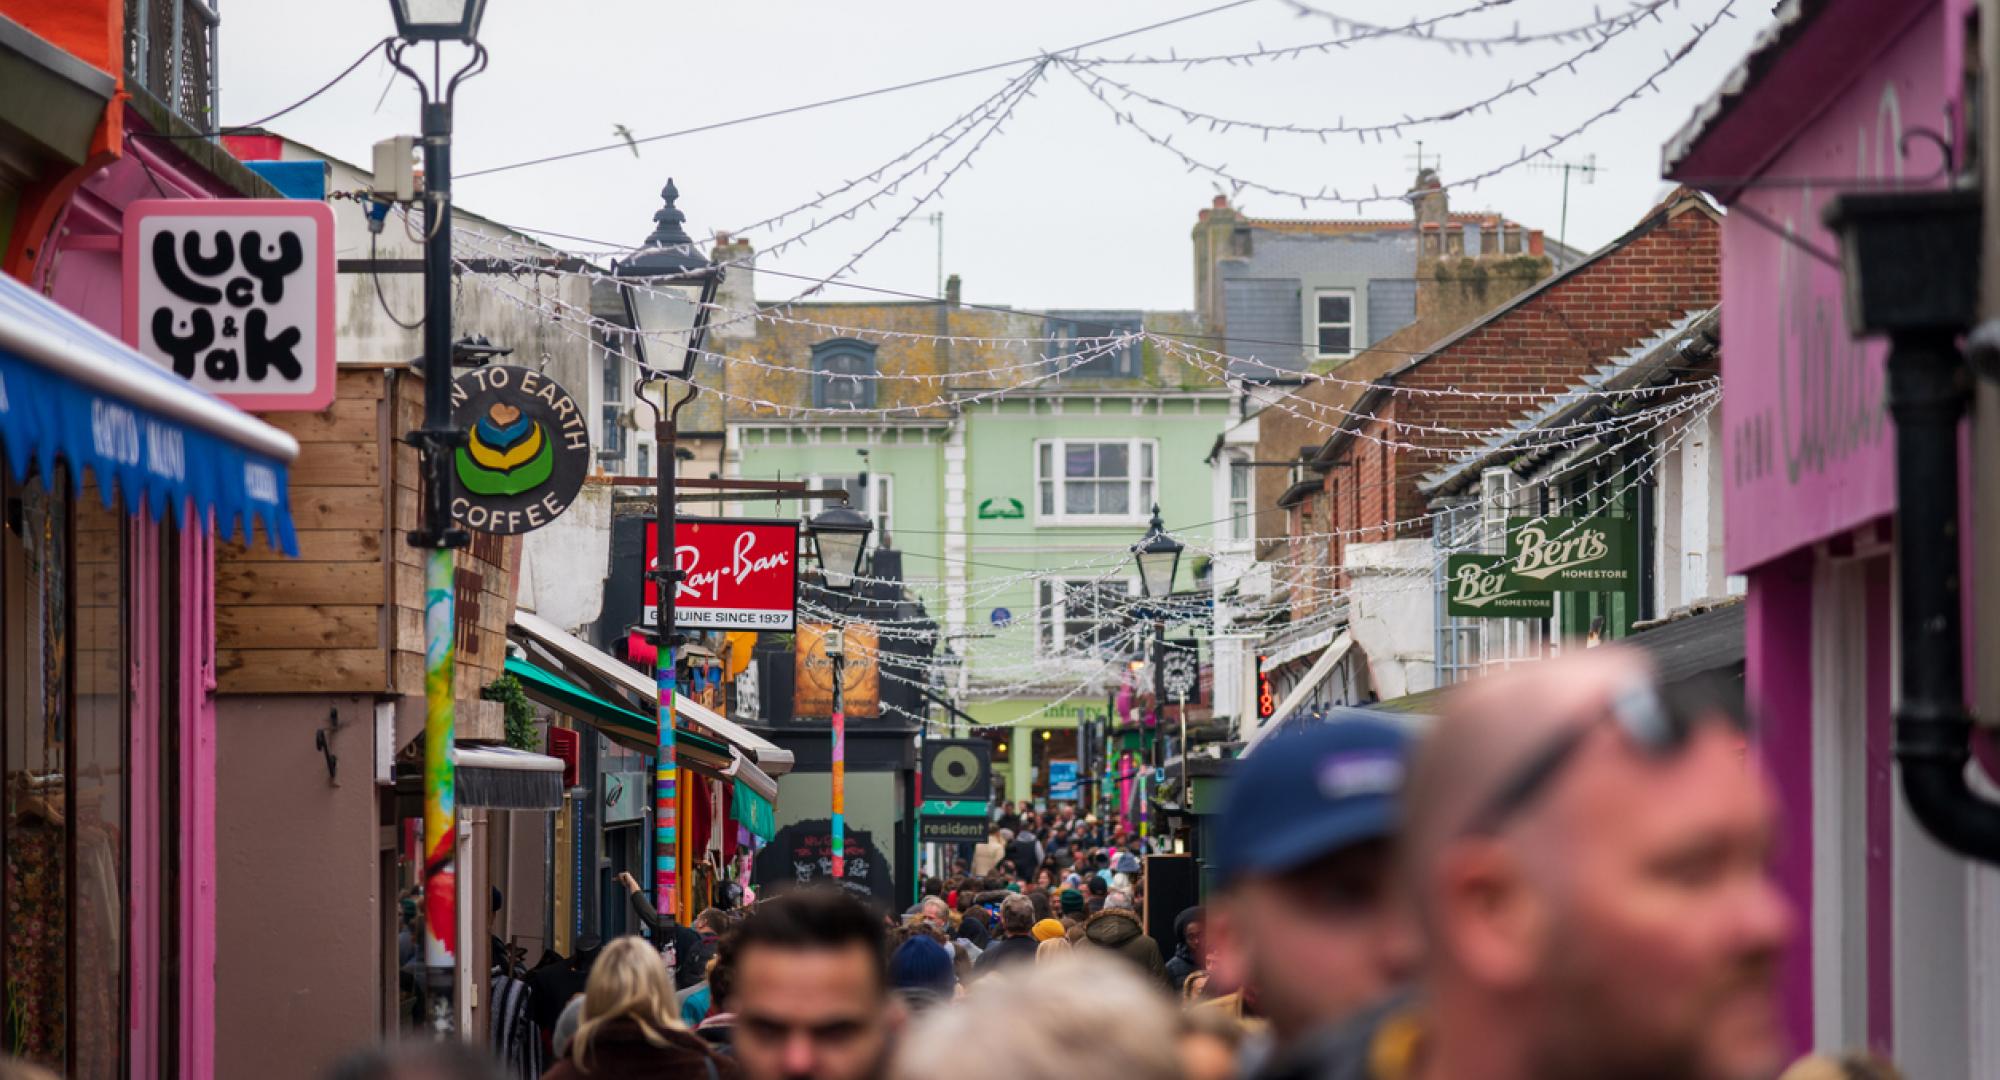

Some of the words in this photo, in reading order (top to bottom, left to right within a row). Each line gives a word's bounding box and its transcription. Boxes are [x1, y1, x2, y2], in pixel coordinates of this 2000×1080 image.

[222, 315, 239, 338] &
[472, 367, 508, 391] TO
[520, 371, 587, 450] EARTH
[452, 491, 565, 533] COFFEE
[1561, 569, 1628, 579] HOMESTORE
[650, 611, 712, 622] GUINE
[715, 612, 757, 623] SINCE
[760, 613, 789, 624] 1937
[924, 822, 984, 835] resident
